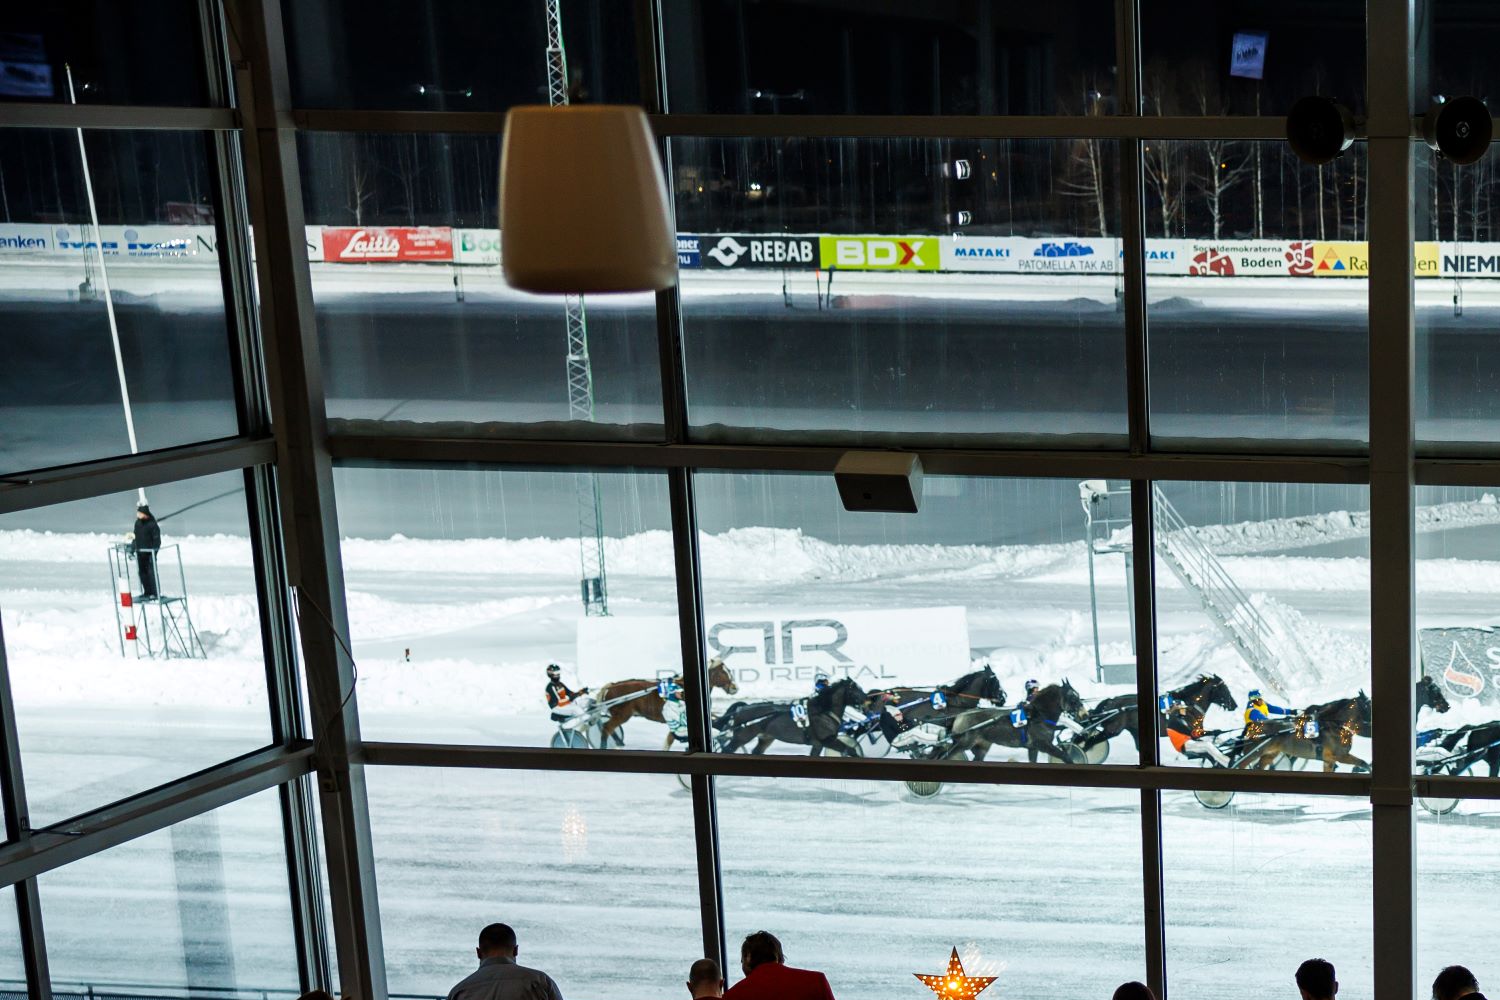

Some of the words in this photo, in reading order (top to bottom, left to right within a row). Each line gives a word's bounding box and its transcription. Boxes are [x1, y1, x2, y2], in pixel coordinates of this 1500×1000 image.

[751, 241, 813, 263] REBAB
[836, 241, 925, 266] BDX
[954, 247, 1010, 257] MATAKI
[1193, 244, 1282, 253] Socialdemokraterna
[1018, 259, 1076, 270] PATOMELLA
[1079, 261, 1098, 270] TAK
[1100, 261, 1114, 270] AB
[1241, 257, 1282, 268] Boden
[1444, 255, 1500, 273] NIEMI
[1015, 709, 1022, 723] 7
